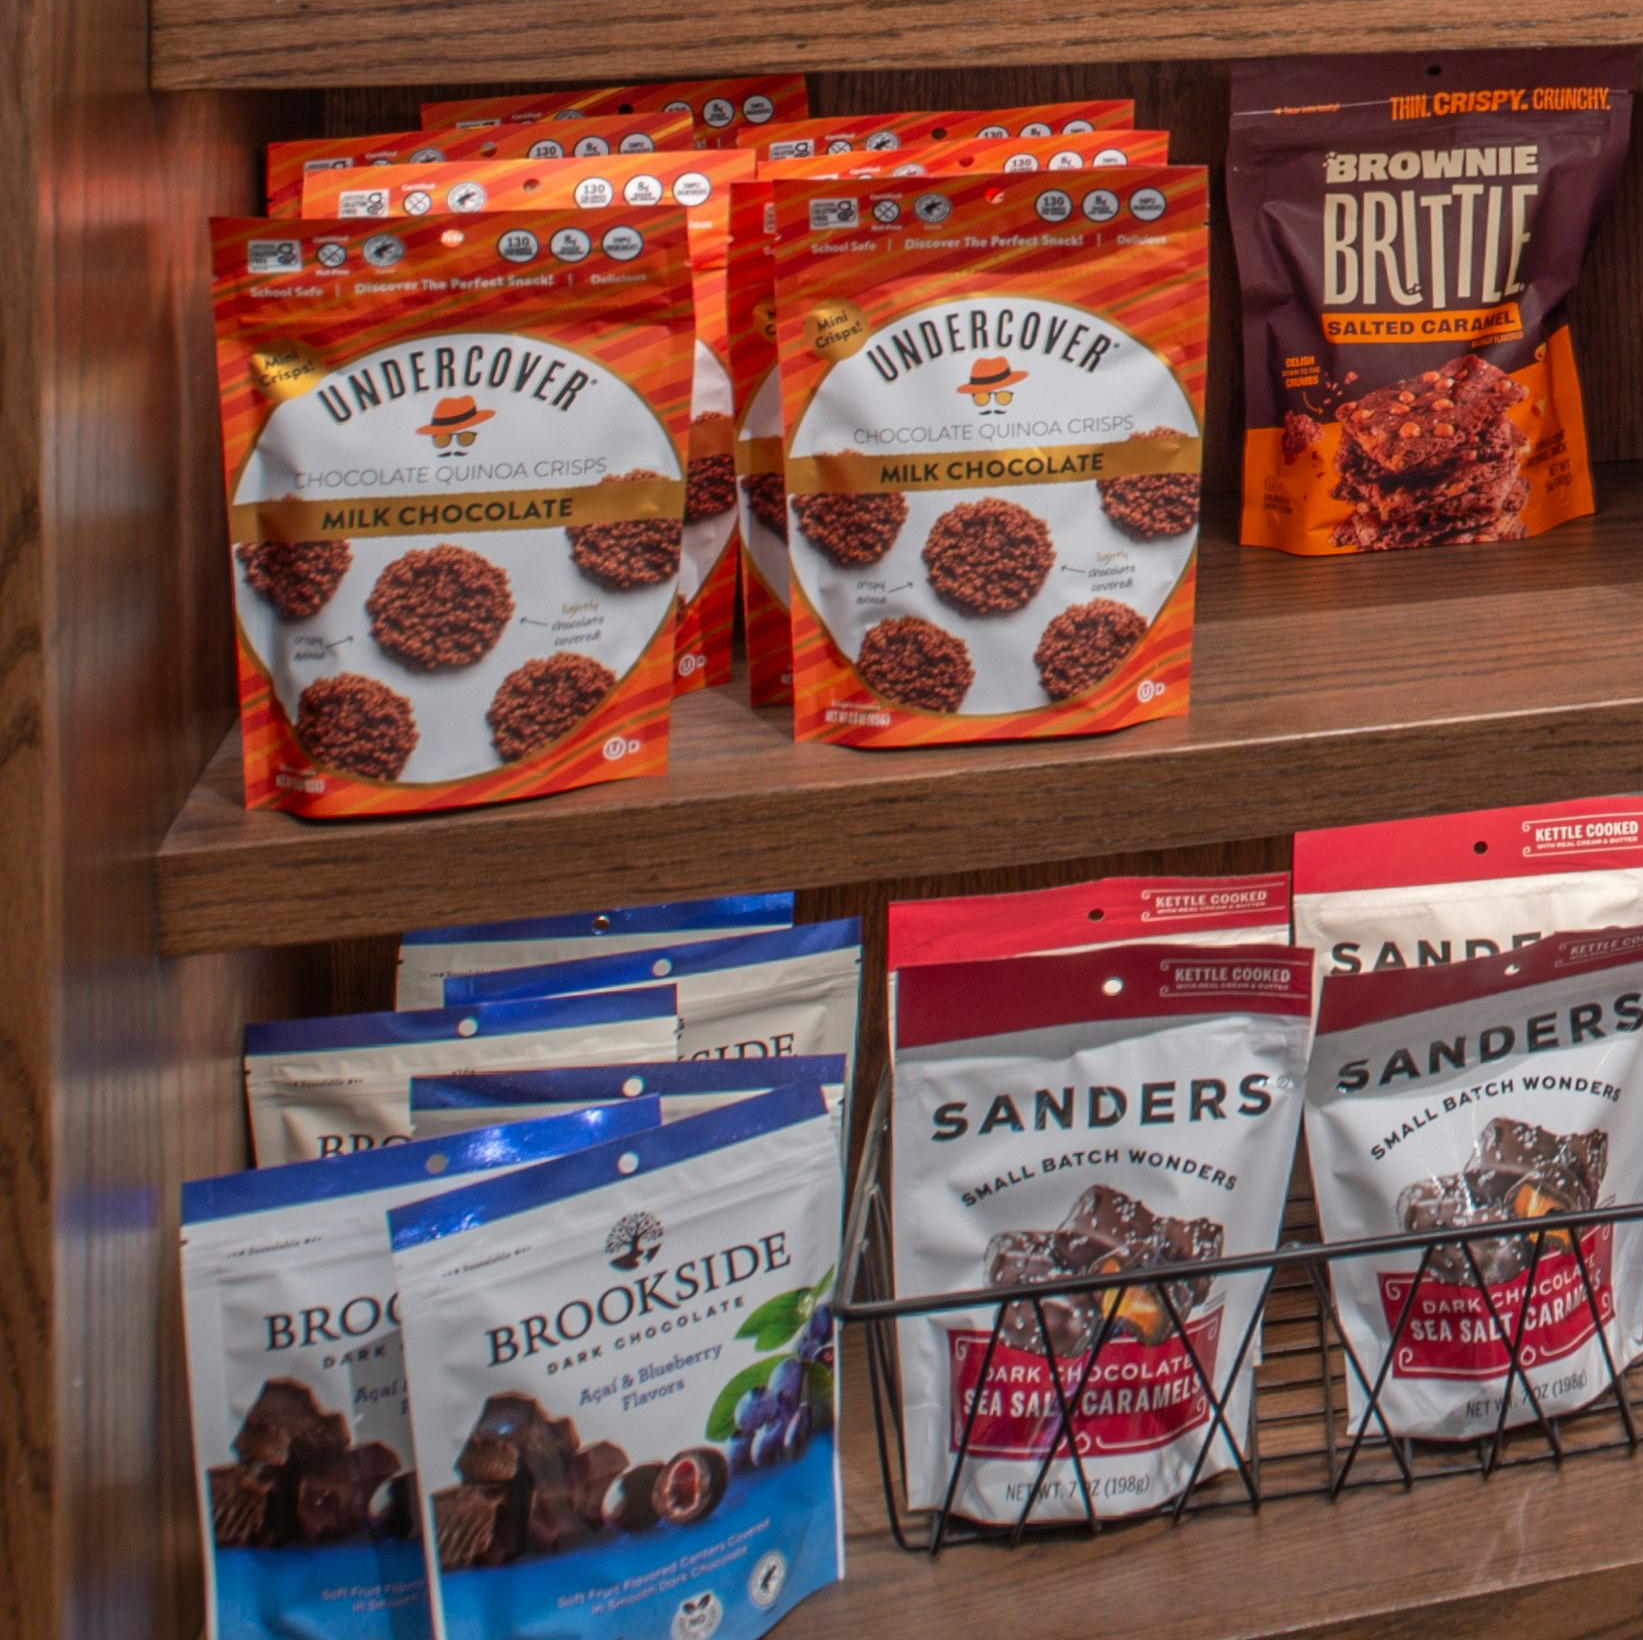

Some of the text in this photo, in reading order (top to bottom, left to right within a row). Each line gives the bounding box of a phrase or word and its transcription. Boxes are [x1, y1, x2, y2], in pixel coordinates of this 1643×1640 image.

[1391, 87, 1611, 121] THIN. CRISPY. CRUNCHY.
[1324, 145, 1538, 184] BROWNIE
[1323, 184, 1538, 309] BRITTLE
[815, 321, 863, 349] Crisps!
[1328, 310, 1515, 337] SALTED CARAMEL
[866, 308, 1110, 385] UNDERCOVER
[317, 345, 592, 426] UNDERCOVER
[852, 415, 1135, 446] CHOCOLATE QUINOA CRISPS
[293, 456, 608, 491] CHOCOLATE QUINOA CRISPS
[880, 453, 1105, 485] MILK CHOCOLATE
[321, 497, 574, 532] MILK CHOCOLATE
[1535, 820, 1639, 842] KETTLE COOKED
[1155, 889, 1267, 908] KETTLE COOKED
[1175, 966, 1291, 983] KETTLE COOKED
[931, 1072, 1275, 1143] SANDERS
[1370, 1074, 1623, 1160] SMALL BATCH WONDERS
[960, 1148, 1239, 1209] SMALL BATCH WONDERS
[487, 1232, 792, 1368] BROOKSIDE
[548, 1294, 747, 1375] DARK CHOCOLATE
[1409, 1311, 1513, 1343] SEA SALT
[579, 1341, 723, 1407] Açaí & Blueberry
[621, 1376, 687, 1411] Flavors
